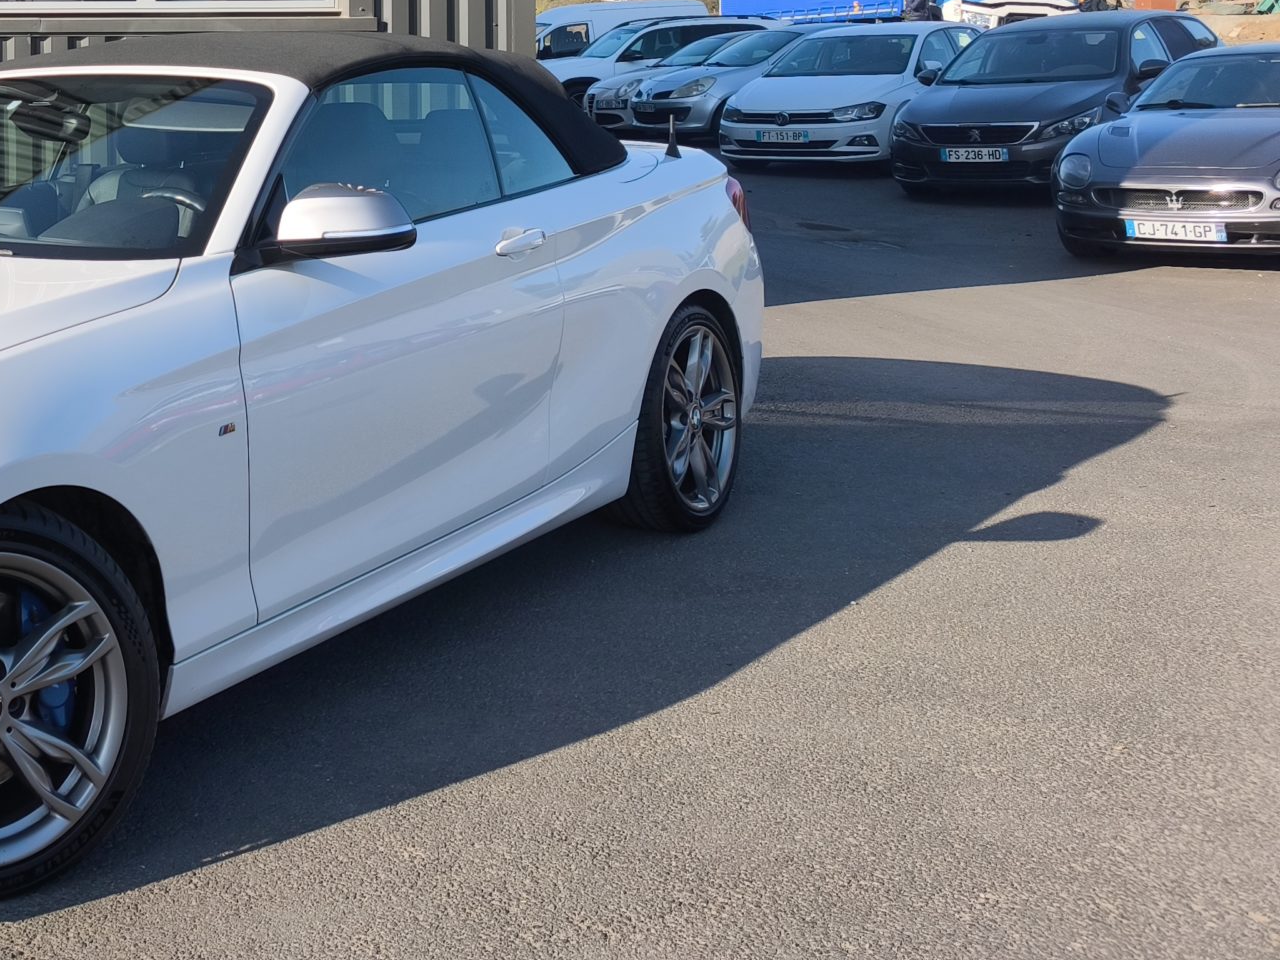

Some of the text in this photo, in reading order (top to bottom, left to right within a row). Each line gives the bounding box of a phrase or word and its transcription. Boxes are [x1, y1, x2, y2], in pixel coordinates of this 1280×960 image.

[762, 131, 803, 141] FT-151-BP
[947, 149, 1001, 160] FS-236-HD
[1137, 222, 1212, 239] CJ-741-GP
